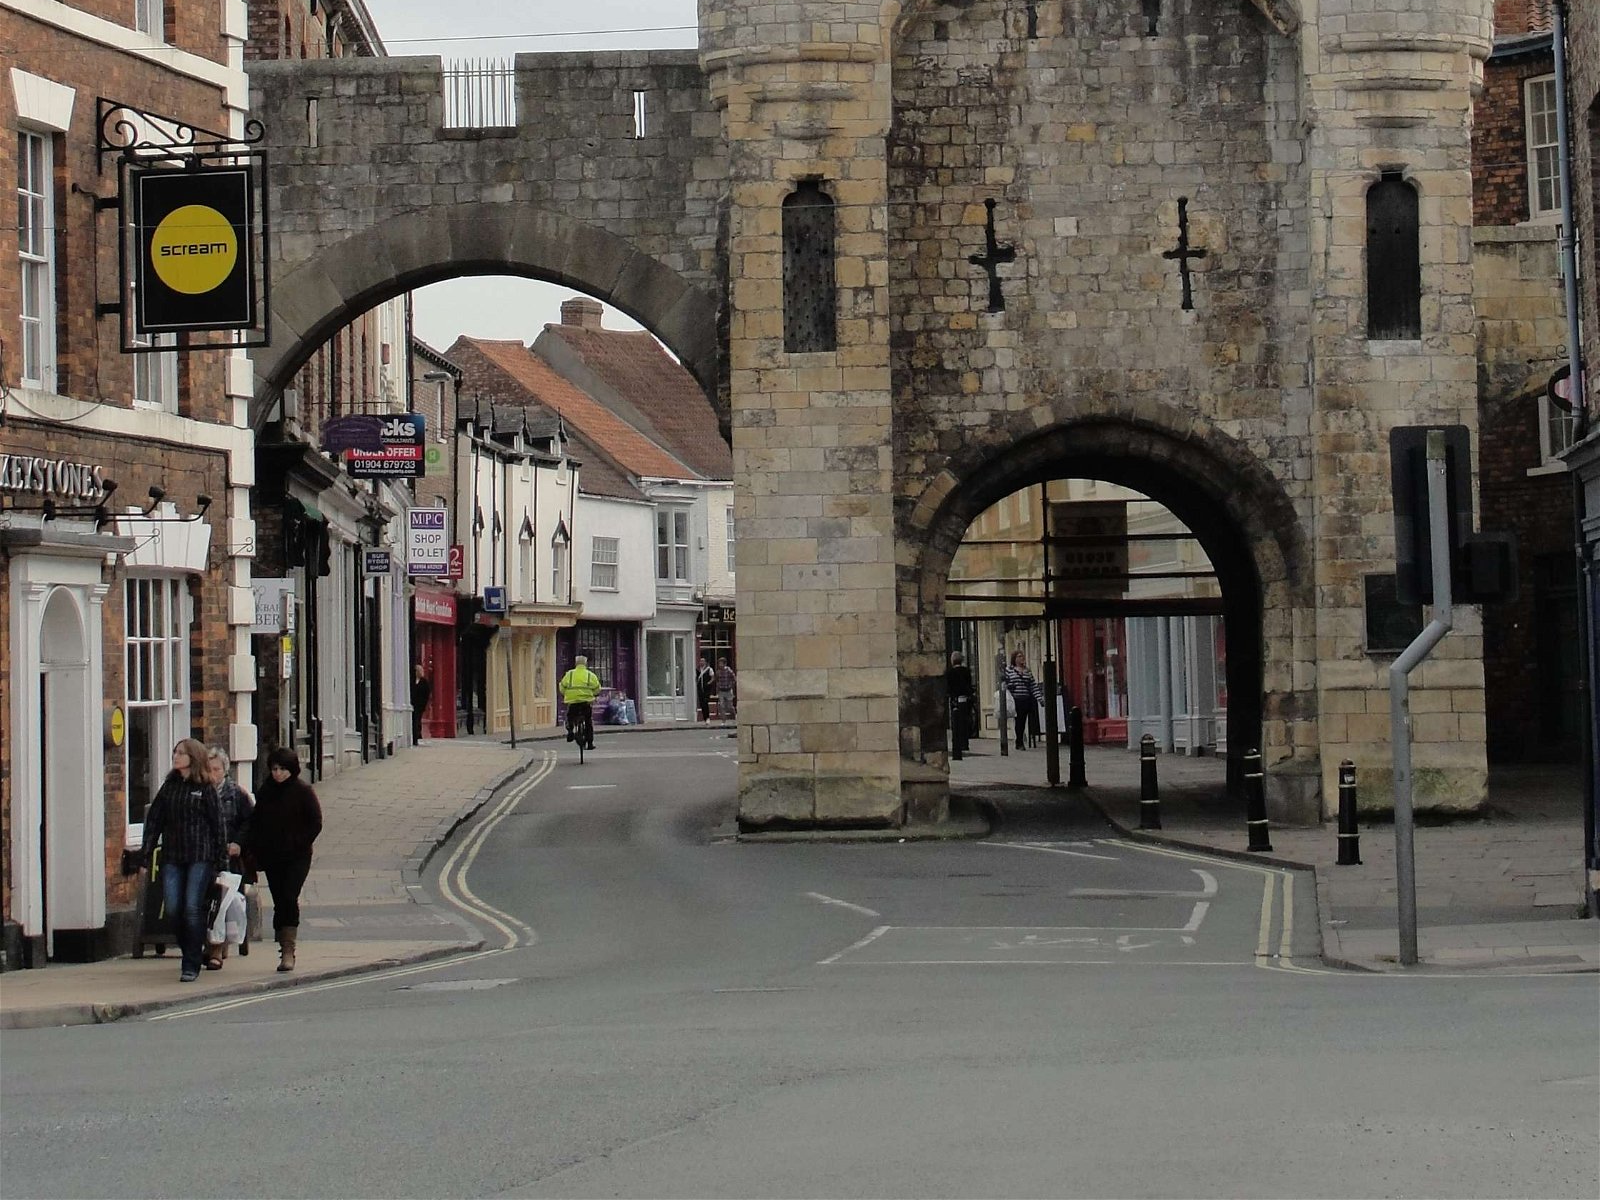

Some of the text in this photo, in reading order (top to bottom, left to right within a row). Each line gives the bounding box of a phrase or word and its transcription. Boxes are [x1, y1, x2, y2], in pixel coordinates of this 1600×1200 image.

[161, 243, 227, 256] scream
[386, 447, 416, 457] OFFER
[354, 460, 382, 469] 01904
[383, 460, 416, 469] 679733
[0, 454, 104, 497] KEYSTONES
[414, 534, 441, 544] SHOP
[412, 548, 444, 558] TO LET
